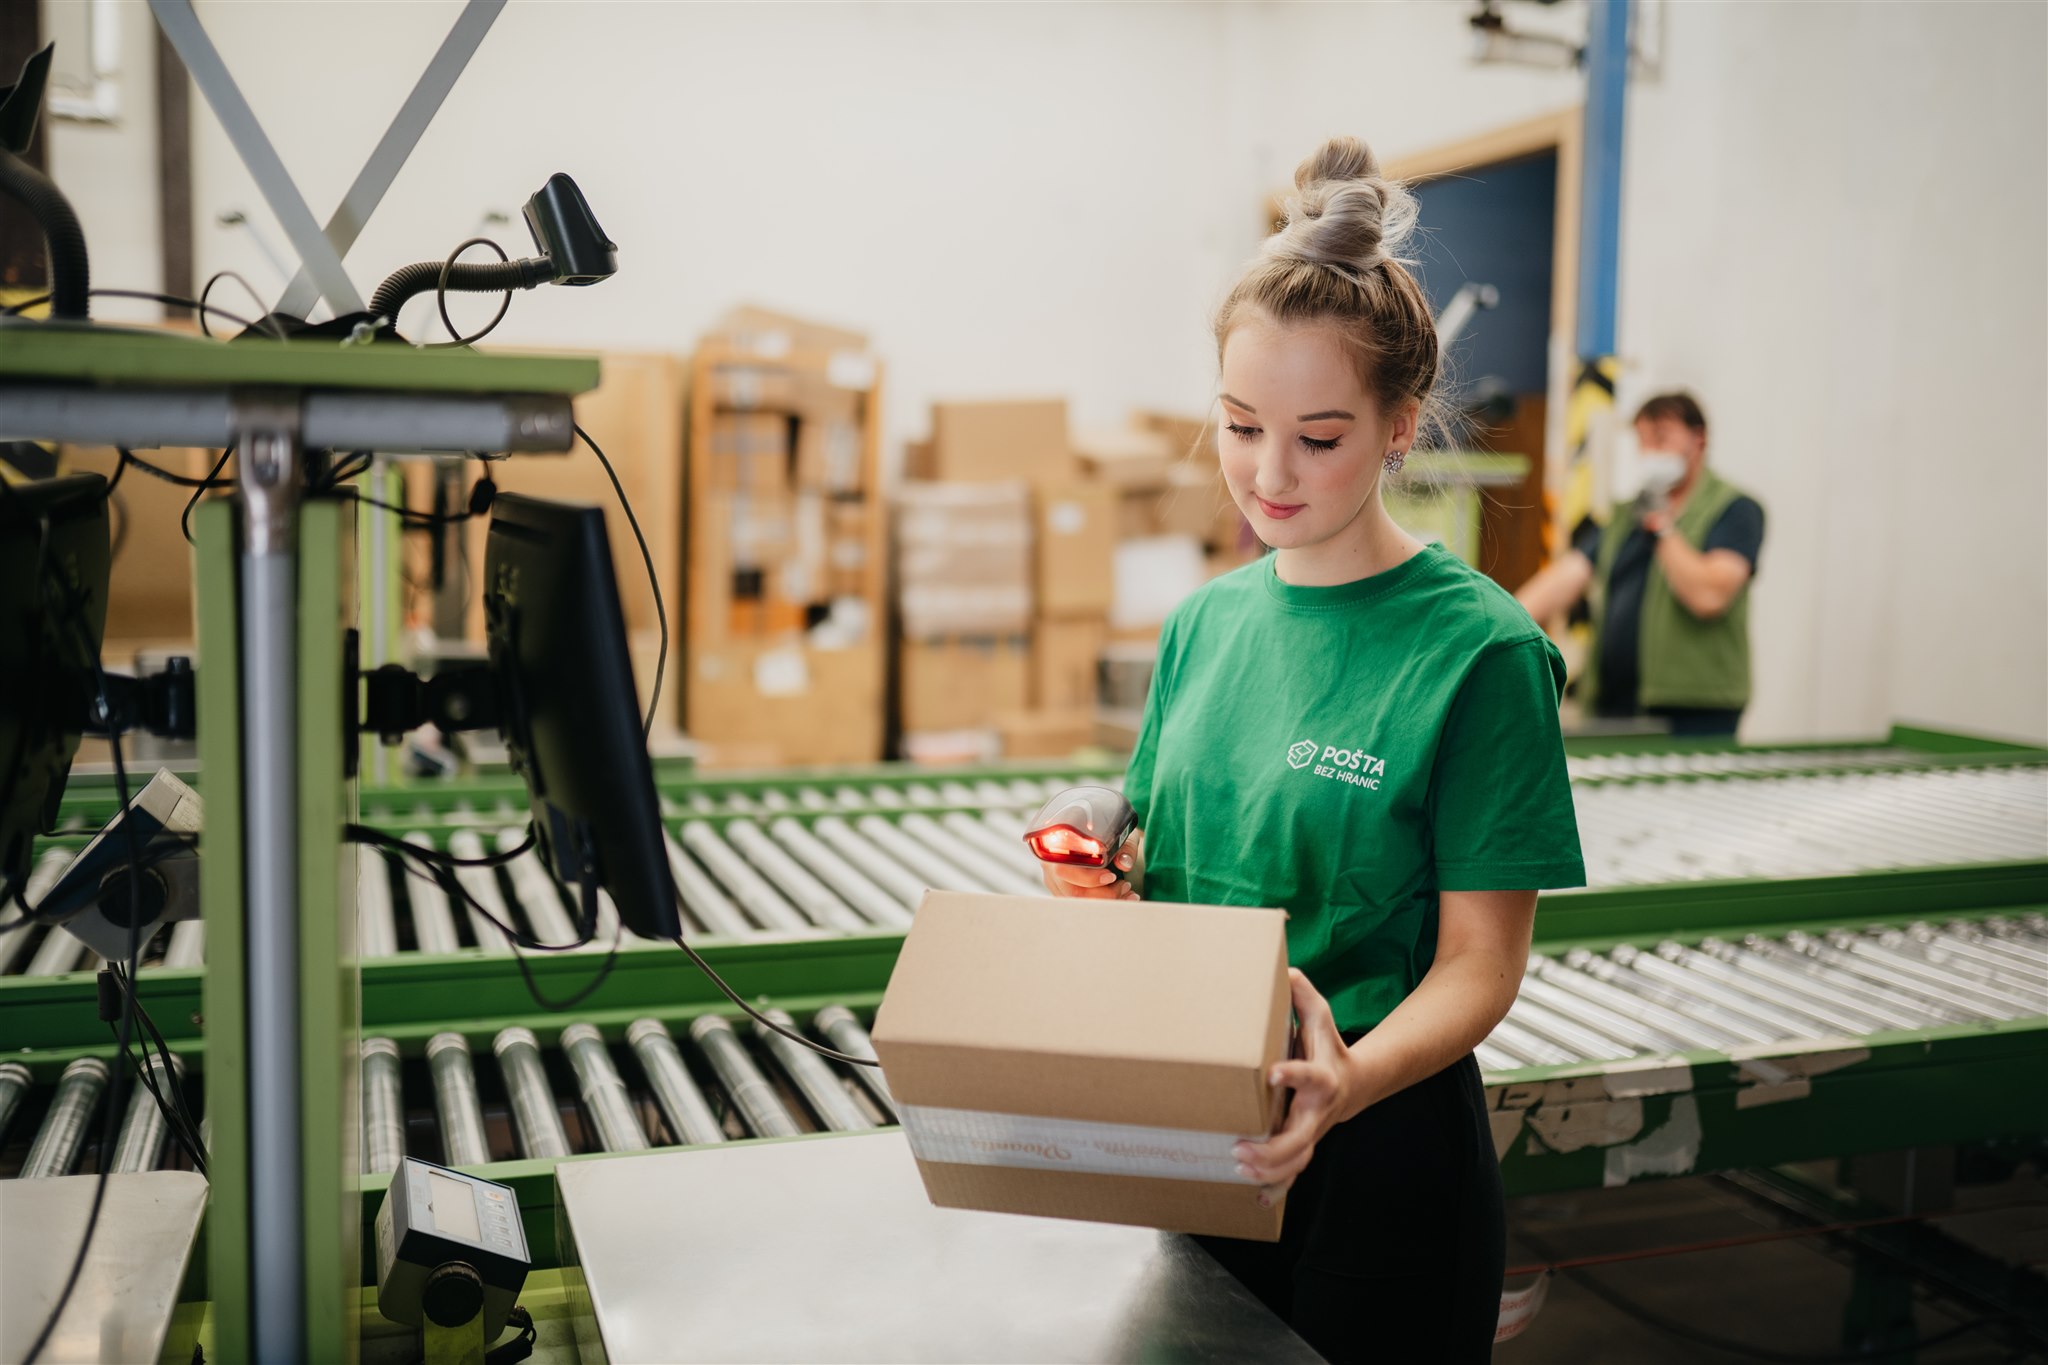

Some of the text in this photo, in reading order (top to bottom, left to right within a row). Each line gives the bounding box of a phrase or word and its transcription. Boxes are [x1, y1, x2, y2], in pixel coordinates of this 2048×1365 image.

[1320, 746, 1386, 777] POŠTA
[1313, 764, 1381, 791] BEZ HRANIC
